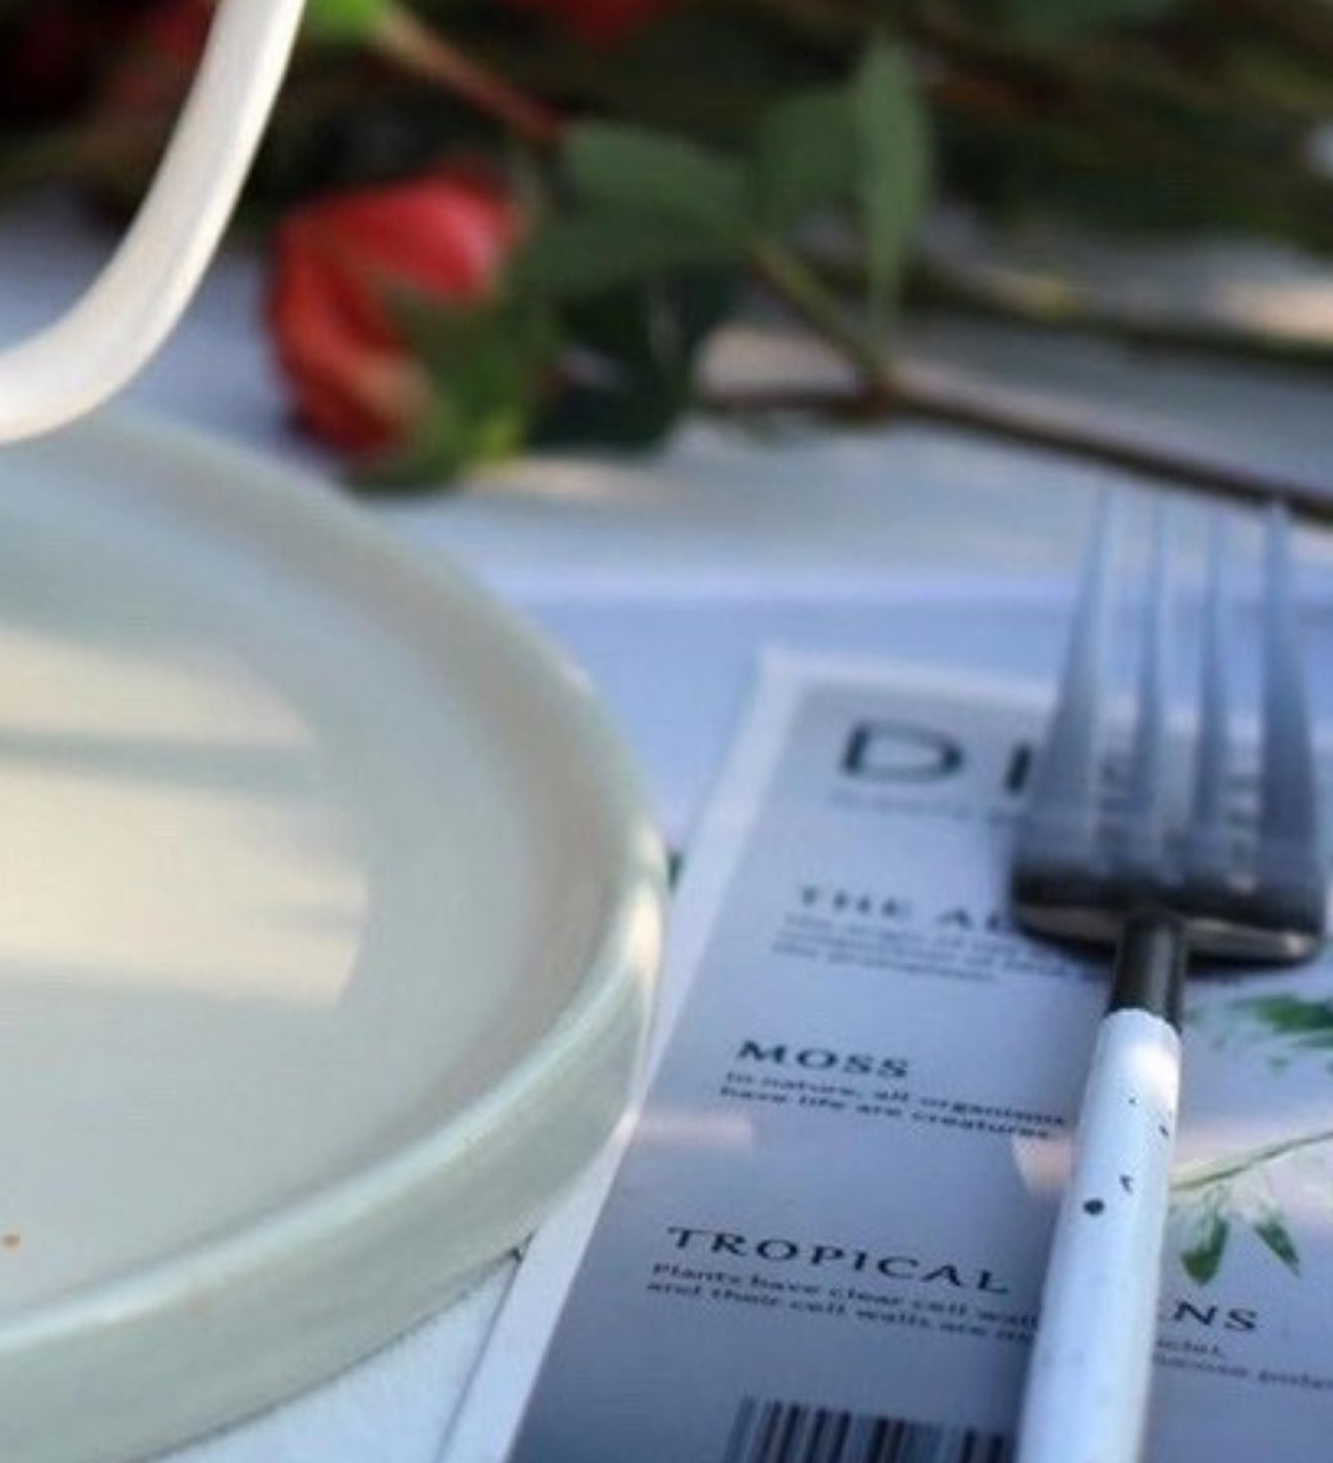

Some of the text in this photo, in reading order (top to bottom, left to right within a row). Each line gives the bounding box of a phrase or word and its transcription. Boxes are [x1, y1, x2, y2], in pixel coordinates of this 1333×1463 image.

[738, 1040, 909, 1078] MOSS
[666, 1226, 1010, 1295] TROPICAL
[646, 1281, 702, 1297] and
[789, 1299, 847, 1317] cell
[751, 1274, 821, 1295] have
[912, 1299, 968, 1317] cell
